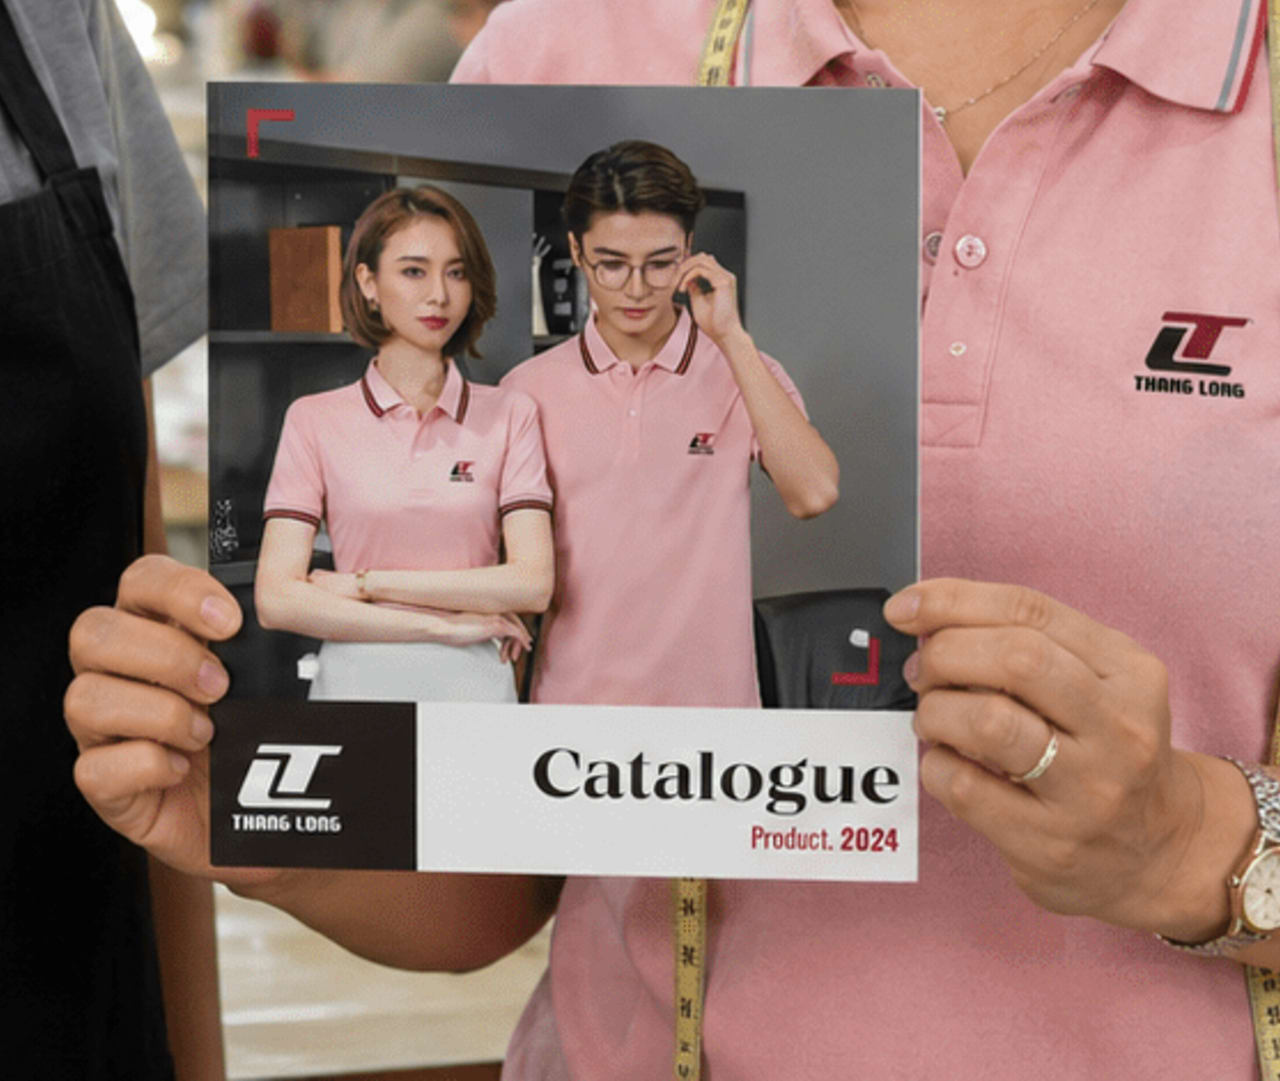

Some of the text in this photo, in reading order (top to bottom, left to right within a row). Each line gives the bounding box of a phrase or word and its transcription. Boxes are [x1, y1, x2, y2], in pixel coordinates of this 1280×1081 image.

[1134, 375, 1194, 395] THANG
[532, 747, 900, 816] Catalogue
[231, 813, 342, 833] THANG LONG
[751, 825, 899, 852] Product. 2024
